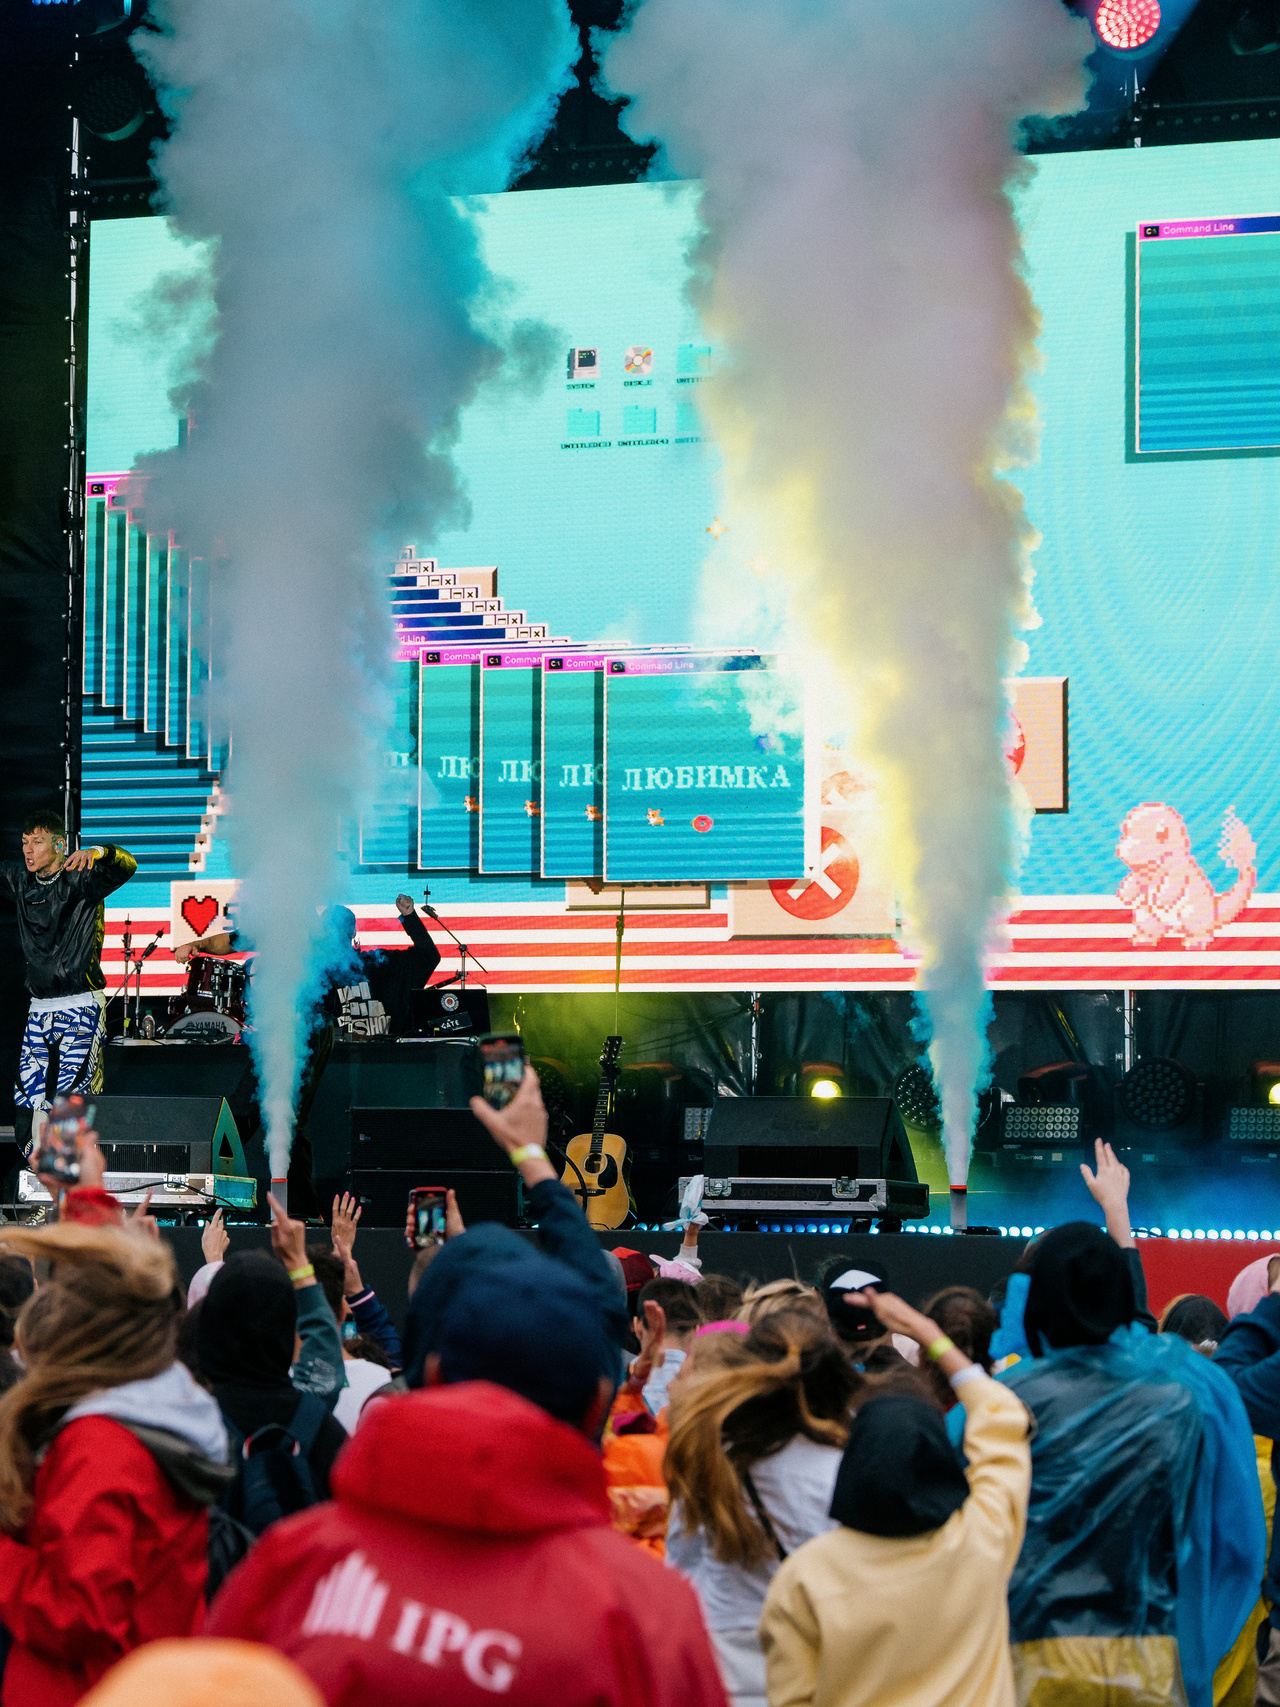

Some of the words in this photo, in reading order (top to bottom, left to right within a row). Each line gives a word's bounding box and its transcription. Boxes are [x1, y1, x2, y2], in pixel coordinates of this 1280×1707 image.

[1163, 224, 1211, 235] Command
[1213, 222, 1235, 232] Line
[628, 662, 673, 671] Command
[675, 661, 694, 669] Line
[622, 764, 791, 791] ЛЮБИМКА
[195, 1021, 225, 1030] YAMAHA
[388, 1598, 523, 1693] IPG
